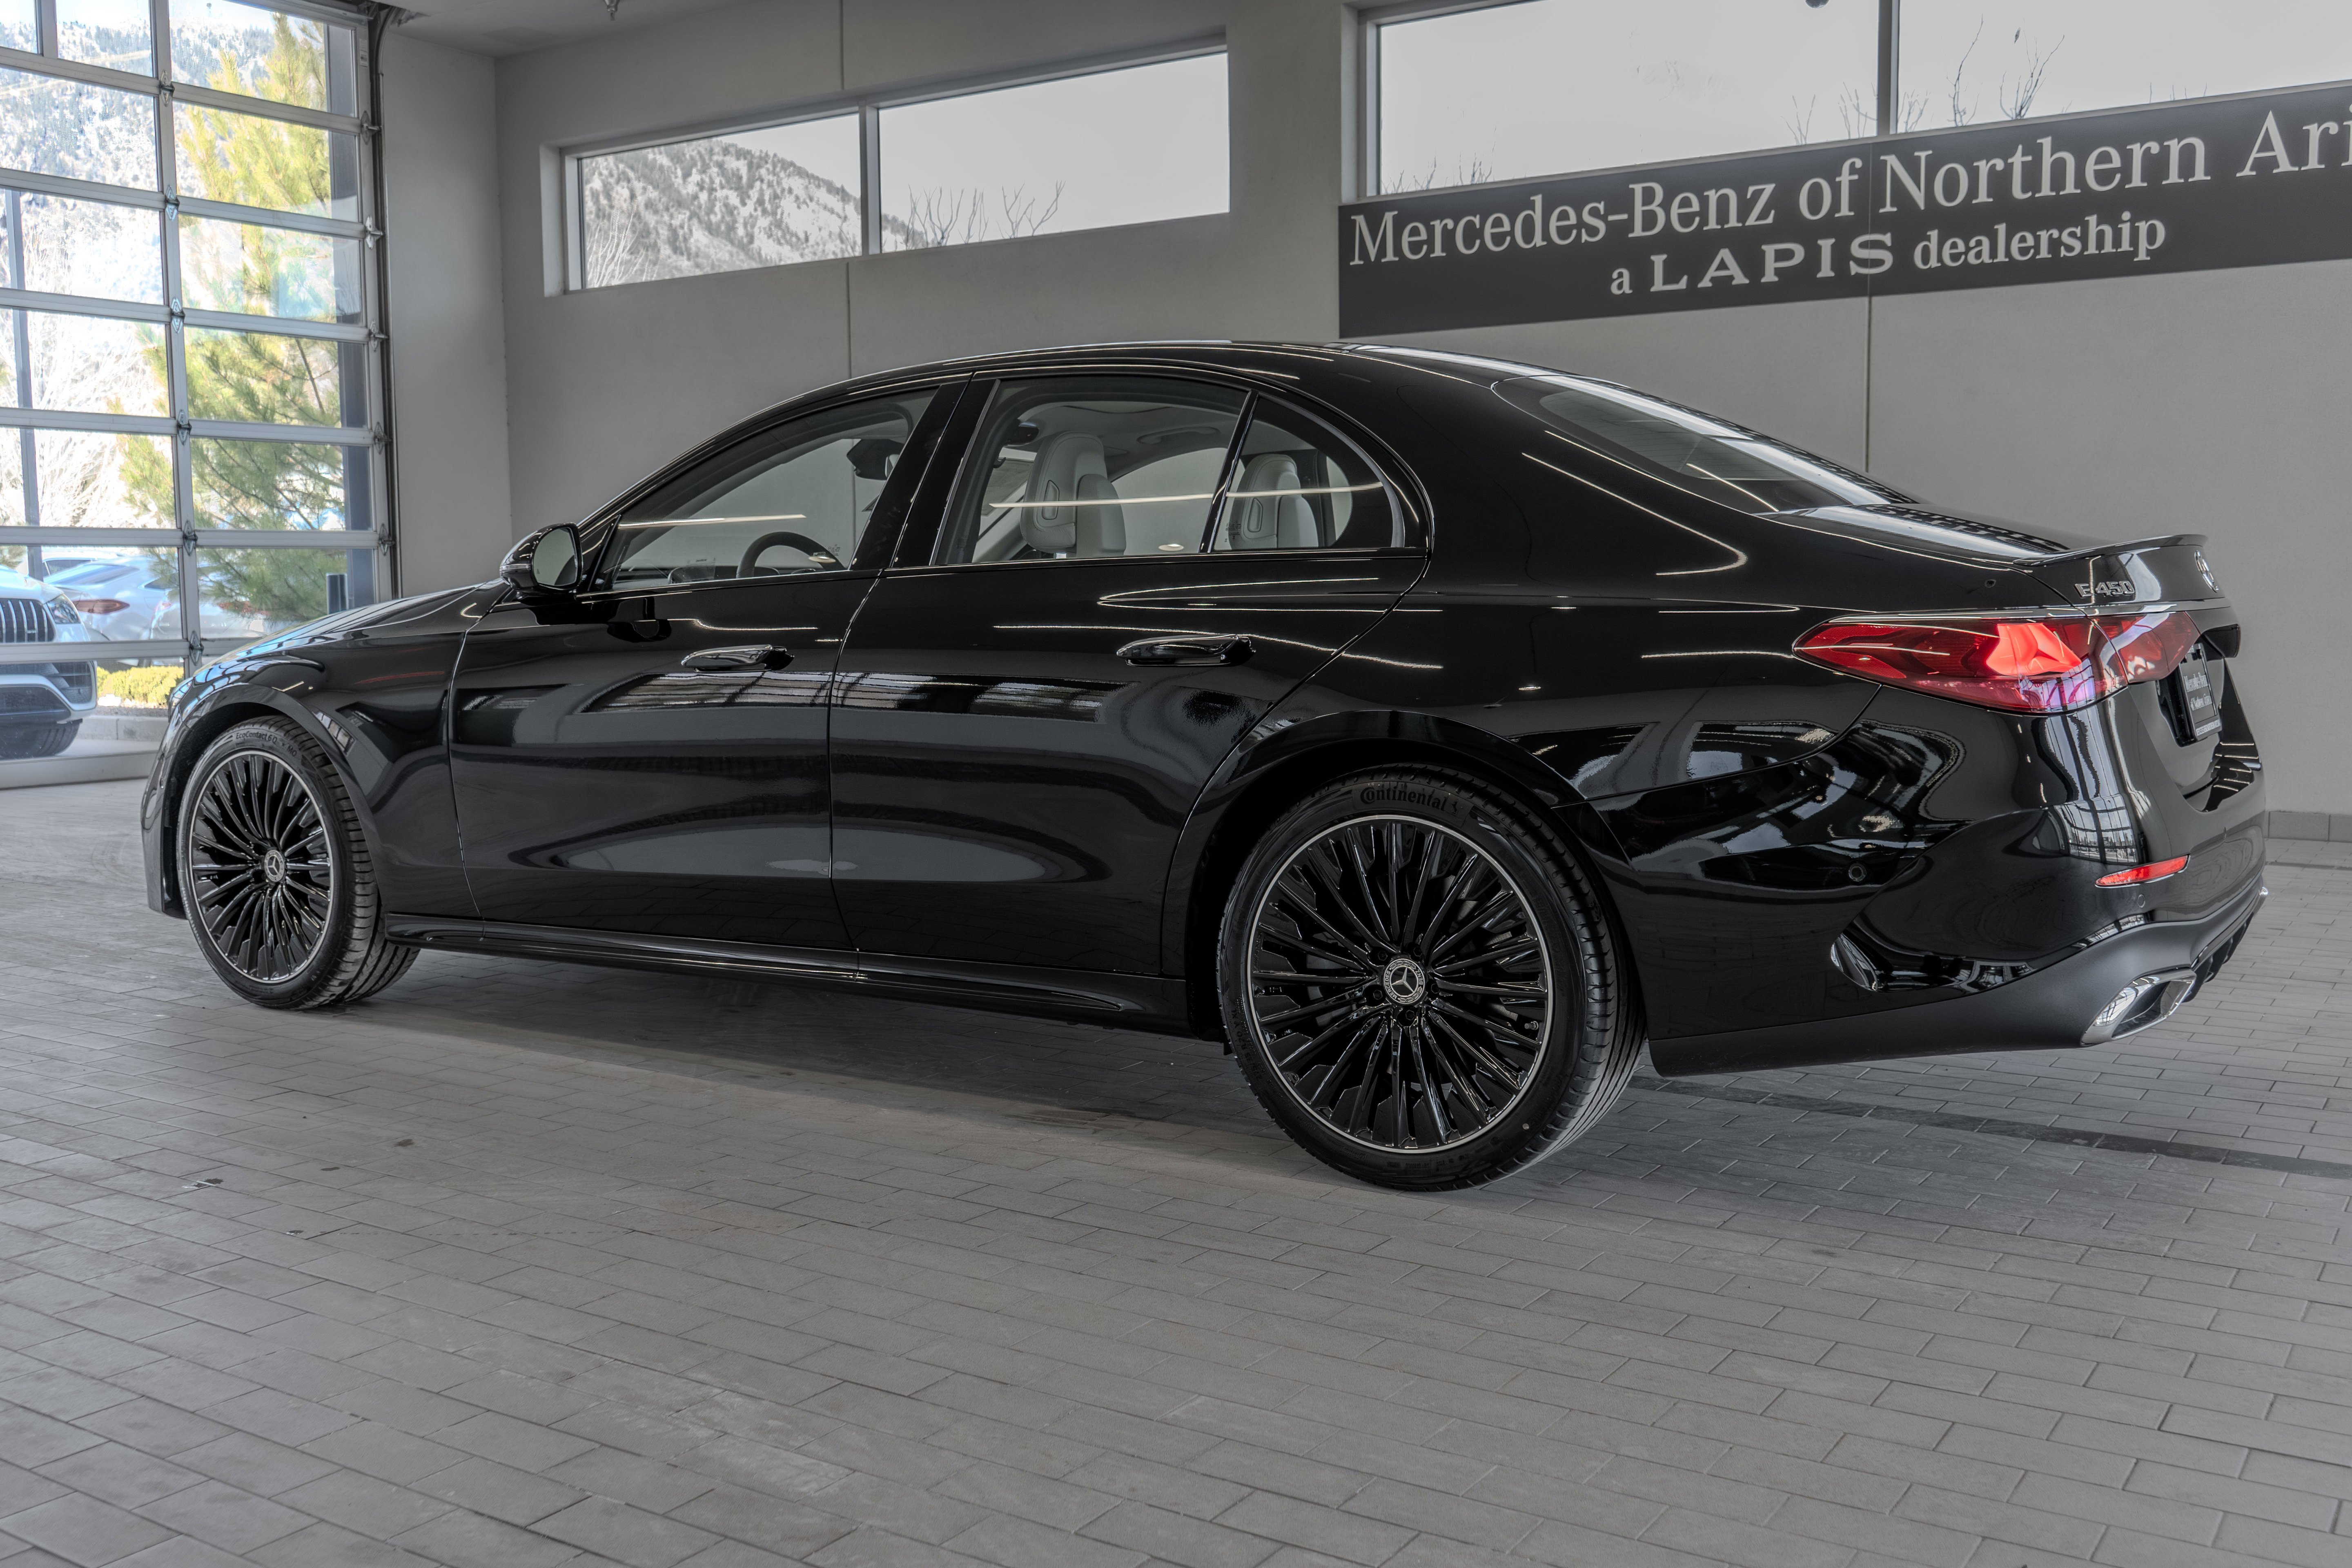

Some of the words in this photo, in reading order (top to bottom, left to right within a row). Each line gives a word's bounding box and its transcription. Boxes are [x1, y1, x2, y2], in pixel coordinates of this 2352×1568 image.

[1349, 181, 1776, 266] Mercedes-Benz
[1798, 158, 1862, 220] of
[1879, 136, 2211, 213] Northern
[1610, 268, 1633, 295] a
[1650, 233, 1893, 292] LAPIS
[1913, 211, 2166, 269] dealership
[2074, 582, 2092, 599] E
[2095, 580, 2136, 597] 450
[236, 731, 267, 741] EcoContact
[1360, 786, 1448, 812] Continental
[1385, 970, 1398, 1000] MERCEDES
[1415, 969, 1423, 985] BENZ
